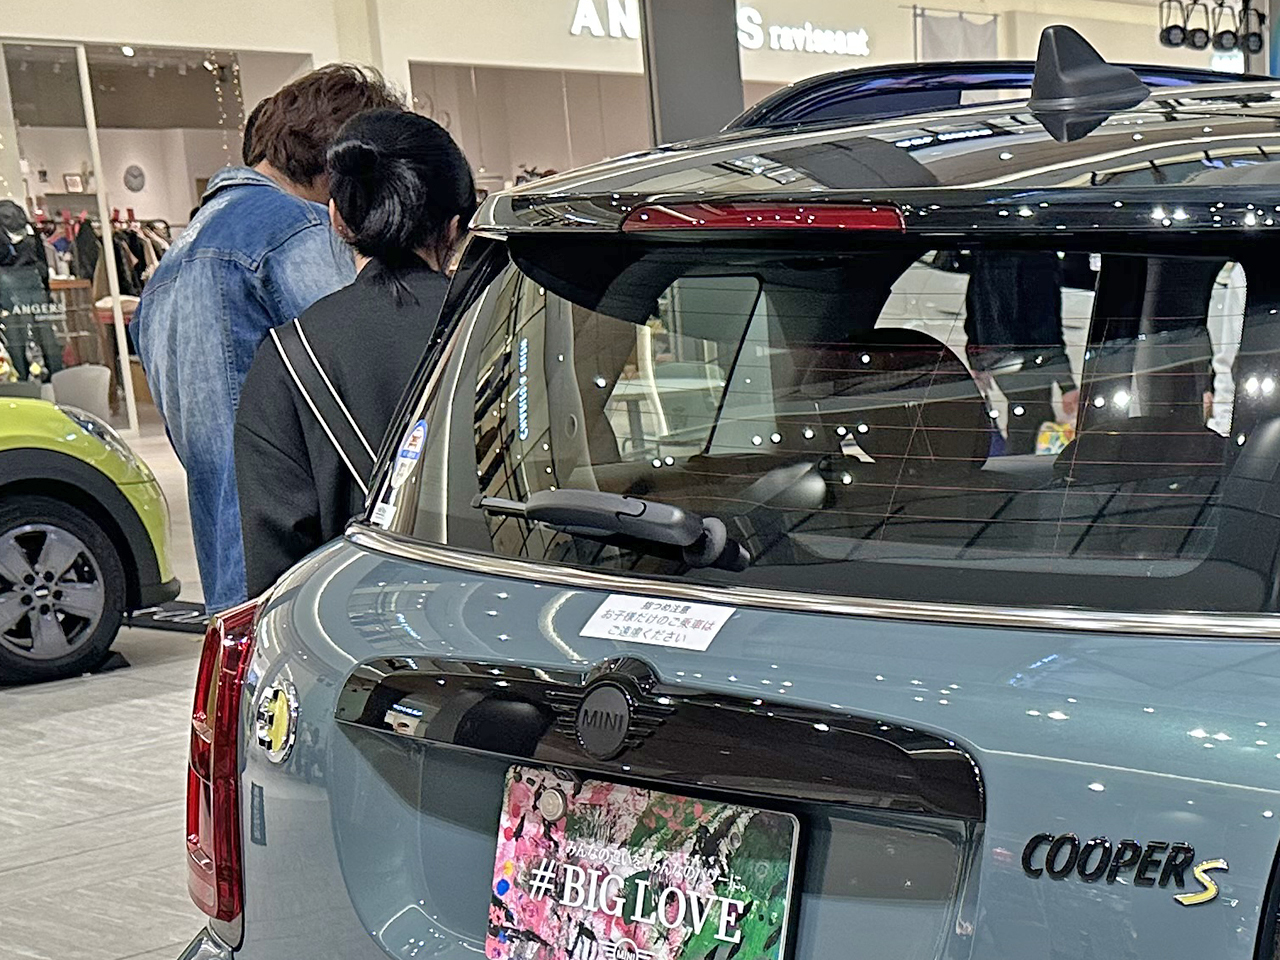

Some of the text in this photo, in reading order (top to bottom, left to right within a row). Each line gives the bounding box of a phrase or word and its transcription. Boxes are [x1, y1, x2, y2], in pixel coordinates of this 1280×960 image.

[582, 708, 624, 732] MINI
[528, 857, 745, 944] #BIG LOVE
